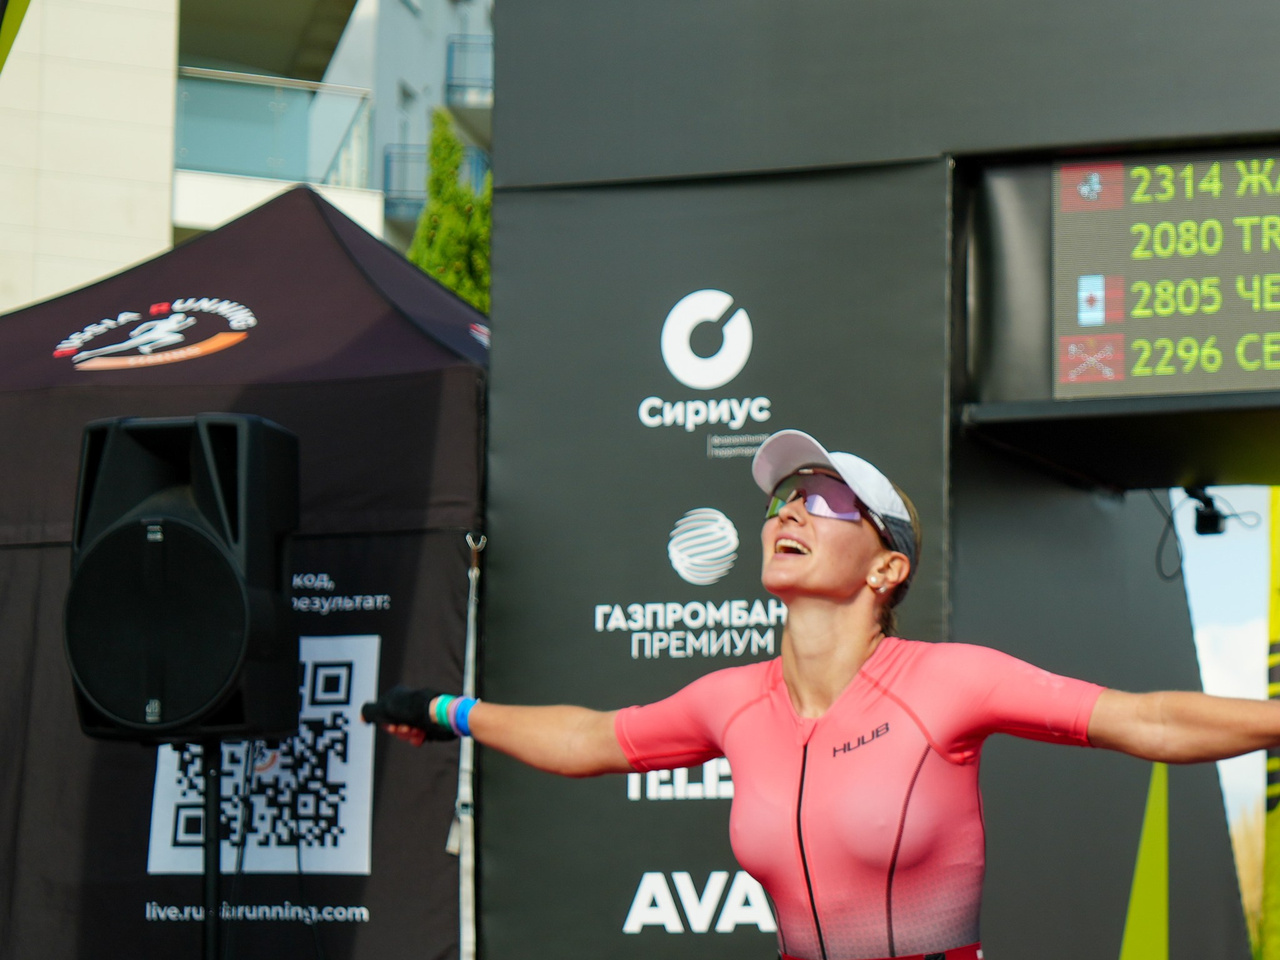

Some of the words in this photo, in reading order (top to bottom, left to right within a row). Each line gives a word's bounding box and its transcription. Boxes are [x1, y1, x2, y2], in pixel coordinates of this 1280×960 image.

[1130, 162, 1222, 203] 2314
[1130, 219, 1223, 259] 2080
[1130, 278, 1222, 318] 2805
[1130, 336, 1223, 376] 2296
[638, 396, 771, 432] Сириус
[594, 598, 788, 632] ГАЗПРОМБАН
[630, 628, 775, 659] ПРЕМИУМ
[832, 722, 890, 757] HUUB
